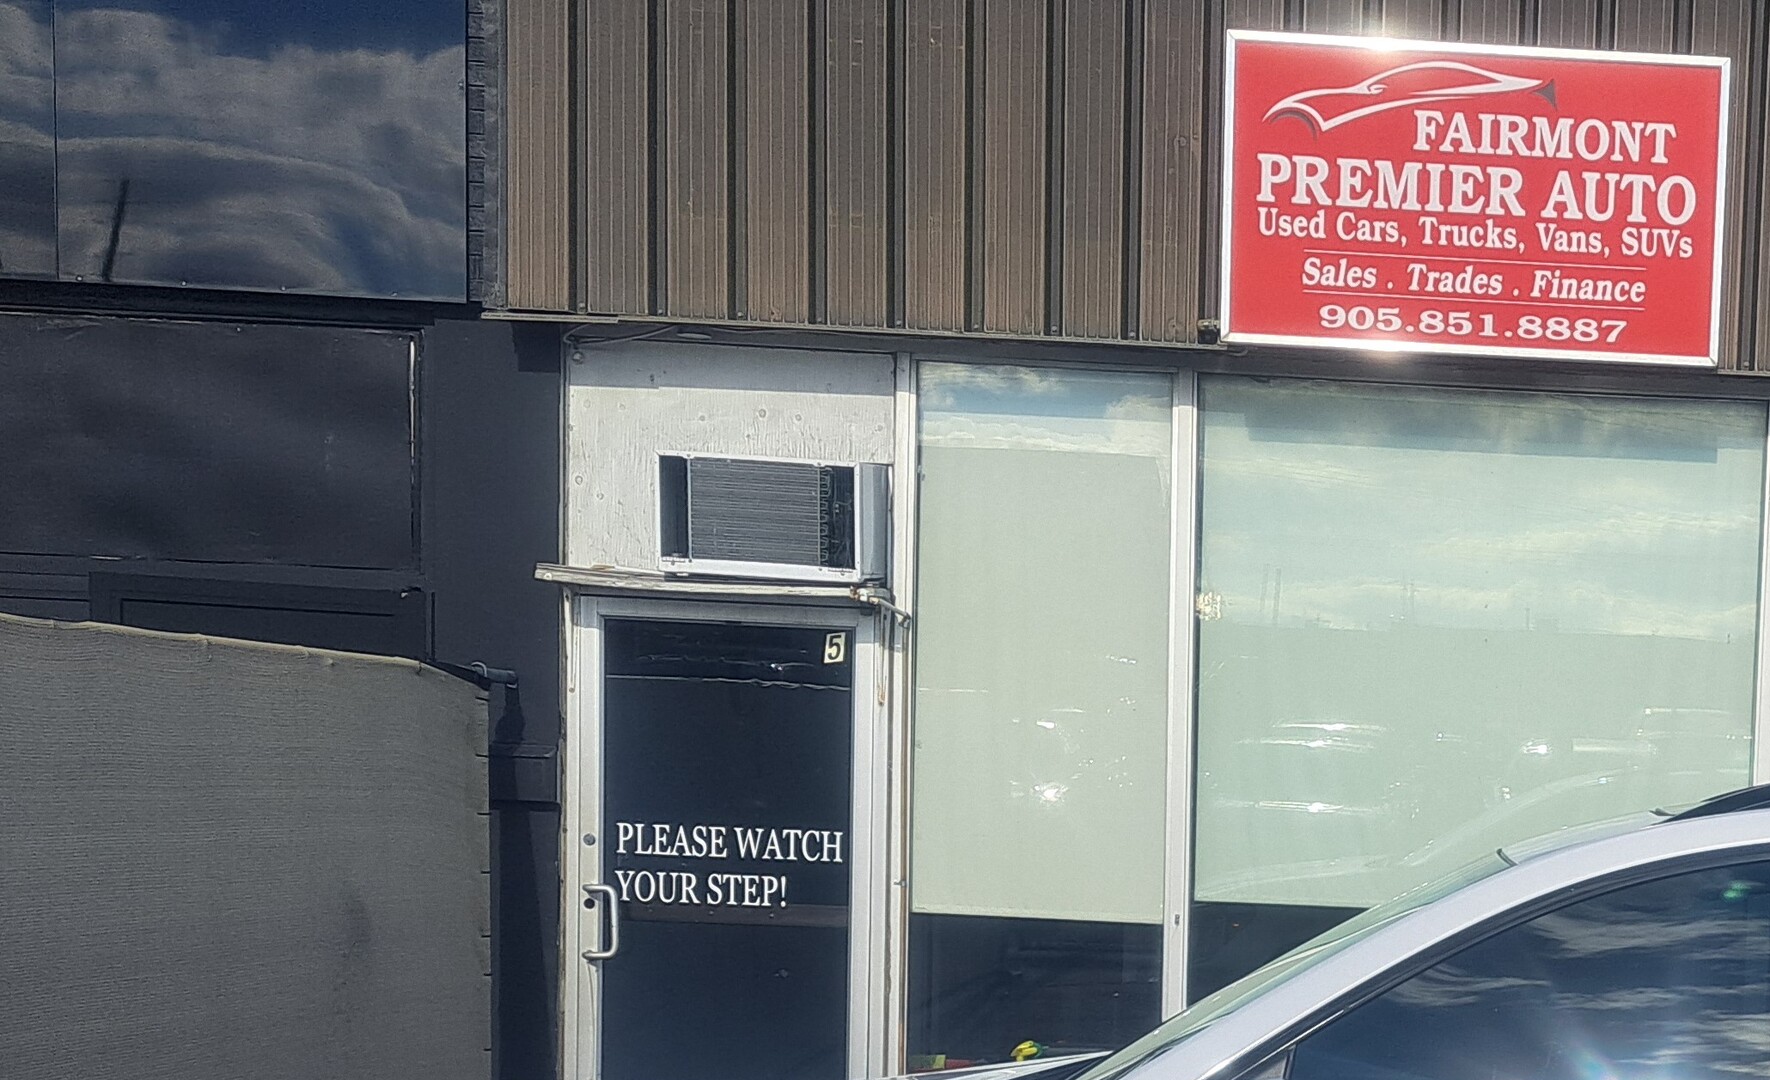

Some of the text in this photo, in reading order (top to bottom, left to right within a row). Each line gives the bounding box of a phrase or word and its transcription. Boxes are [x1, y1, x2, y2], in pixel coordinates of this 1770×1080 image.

[1413, 109, 1677, 164] FAIRMONT
[1256, 153, 1697, 225] PREMIER AUTO
[1258, 207, 1693, 258] Used Cars, Trucks, Vans, SUVs
[1302, 257, 1377, 289] Sales
[1407, 263, 1503, 295] Trades
[1530, 269, 1646, 302] Finance
[1319, 304, 1627, 343] 905.851.8887
[826, 634, 843, 660] 5
[615, 822, 843, 863] PLEASE WATCH
[615, 870, 788, 908] YOUR STEP!
